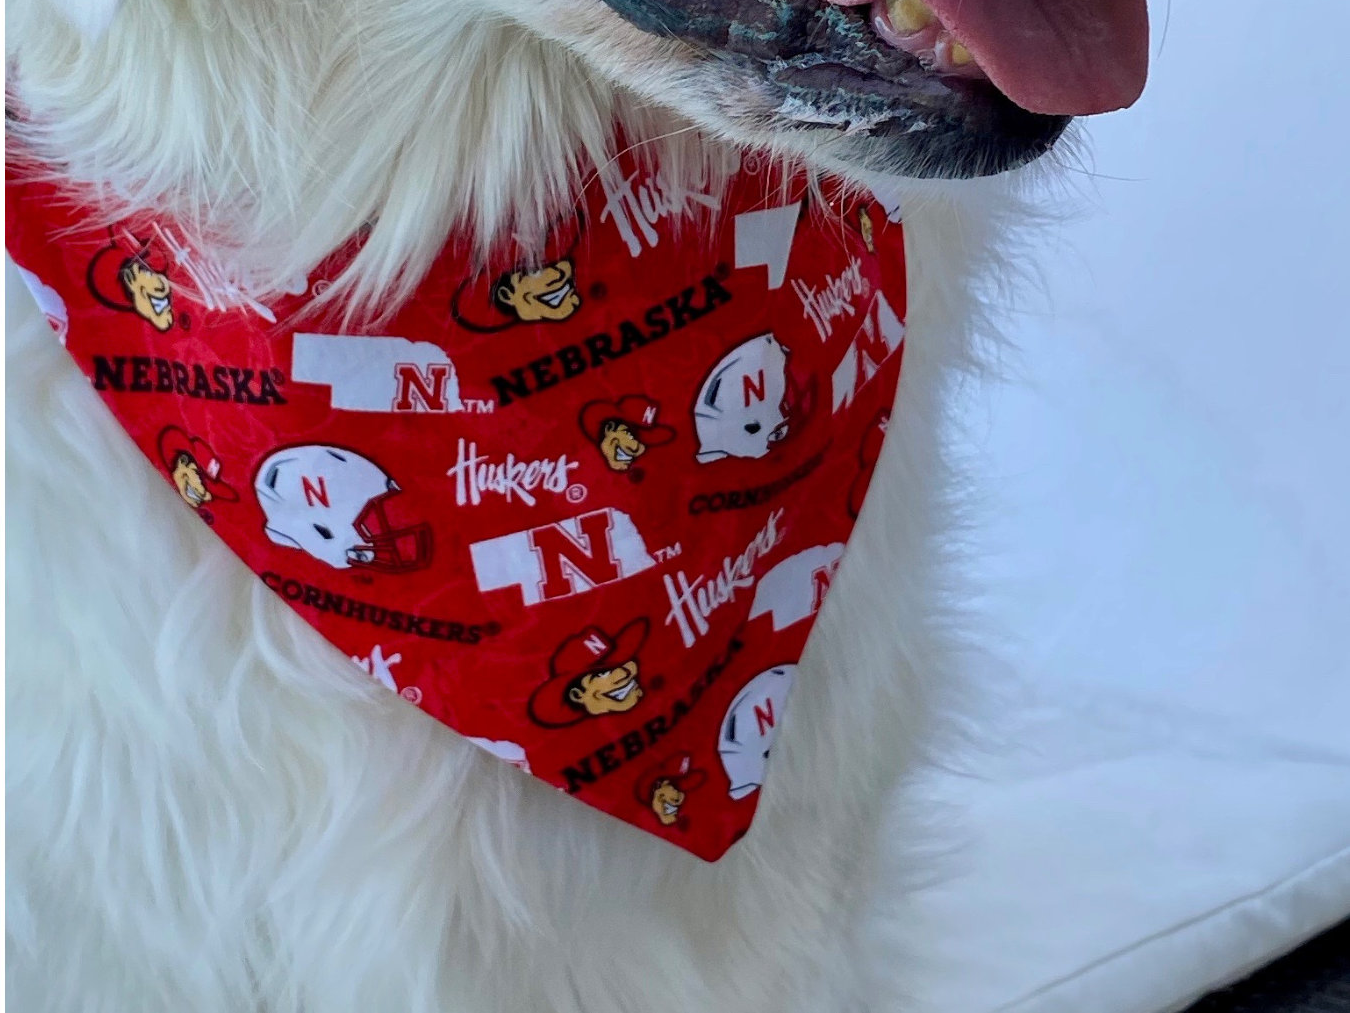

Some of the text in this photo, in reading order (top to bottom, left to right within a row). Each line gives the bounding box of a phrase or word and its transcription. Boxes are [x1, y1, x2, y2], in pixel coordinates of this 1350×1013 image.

[490, 272, 733, 409] NEBRASKA
[393, 362, 453, 413] N
[301, 474, 331, 509] N
[446, 437, 580, 507] Huskers
[527, 505, 625, 603] N
